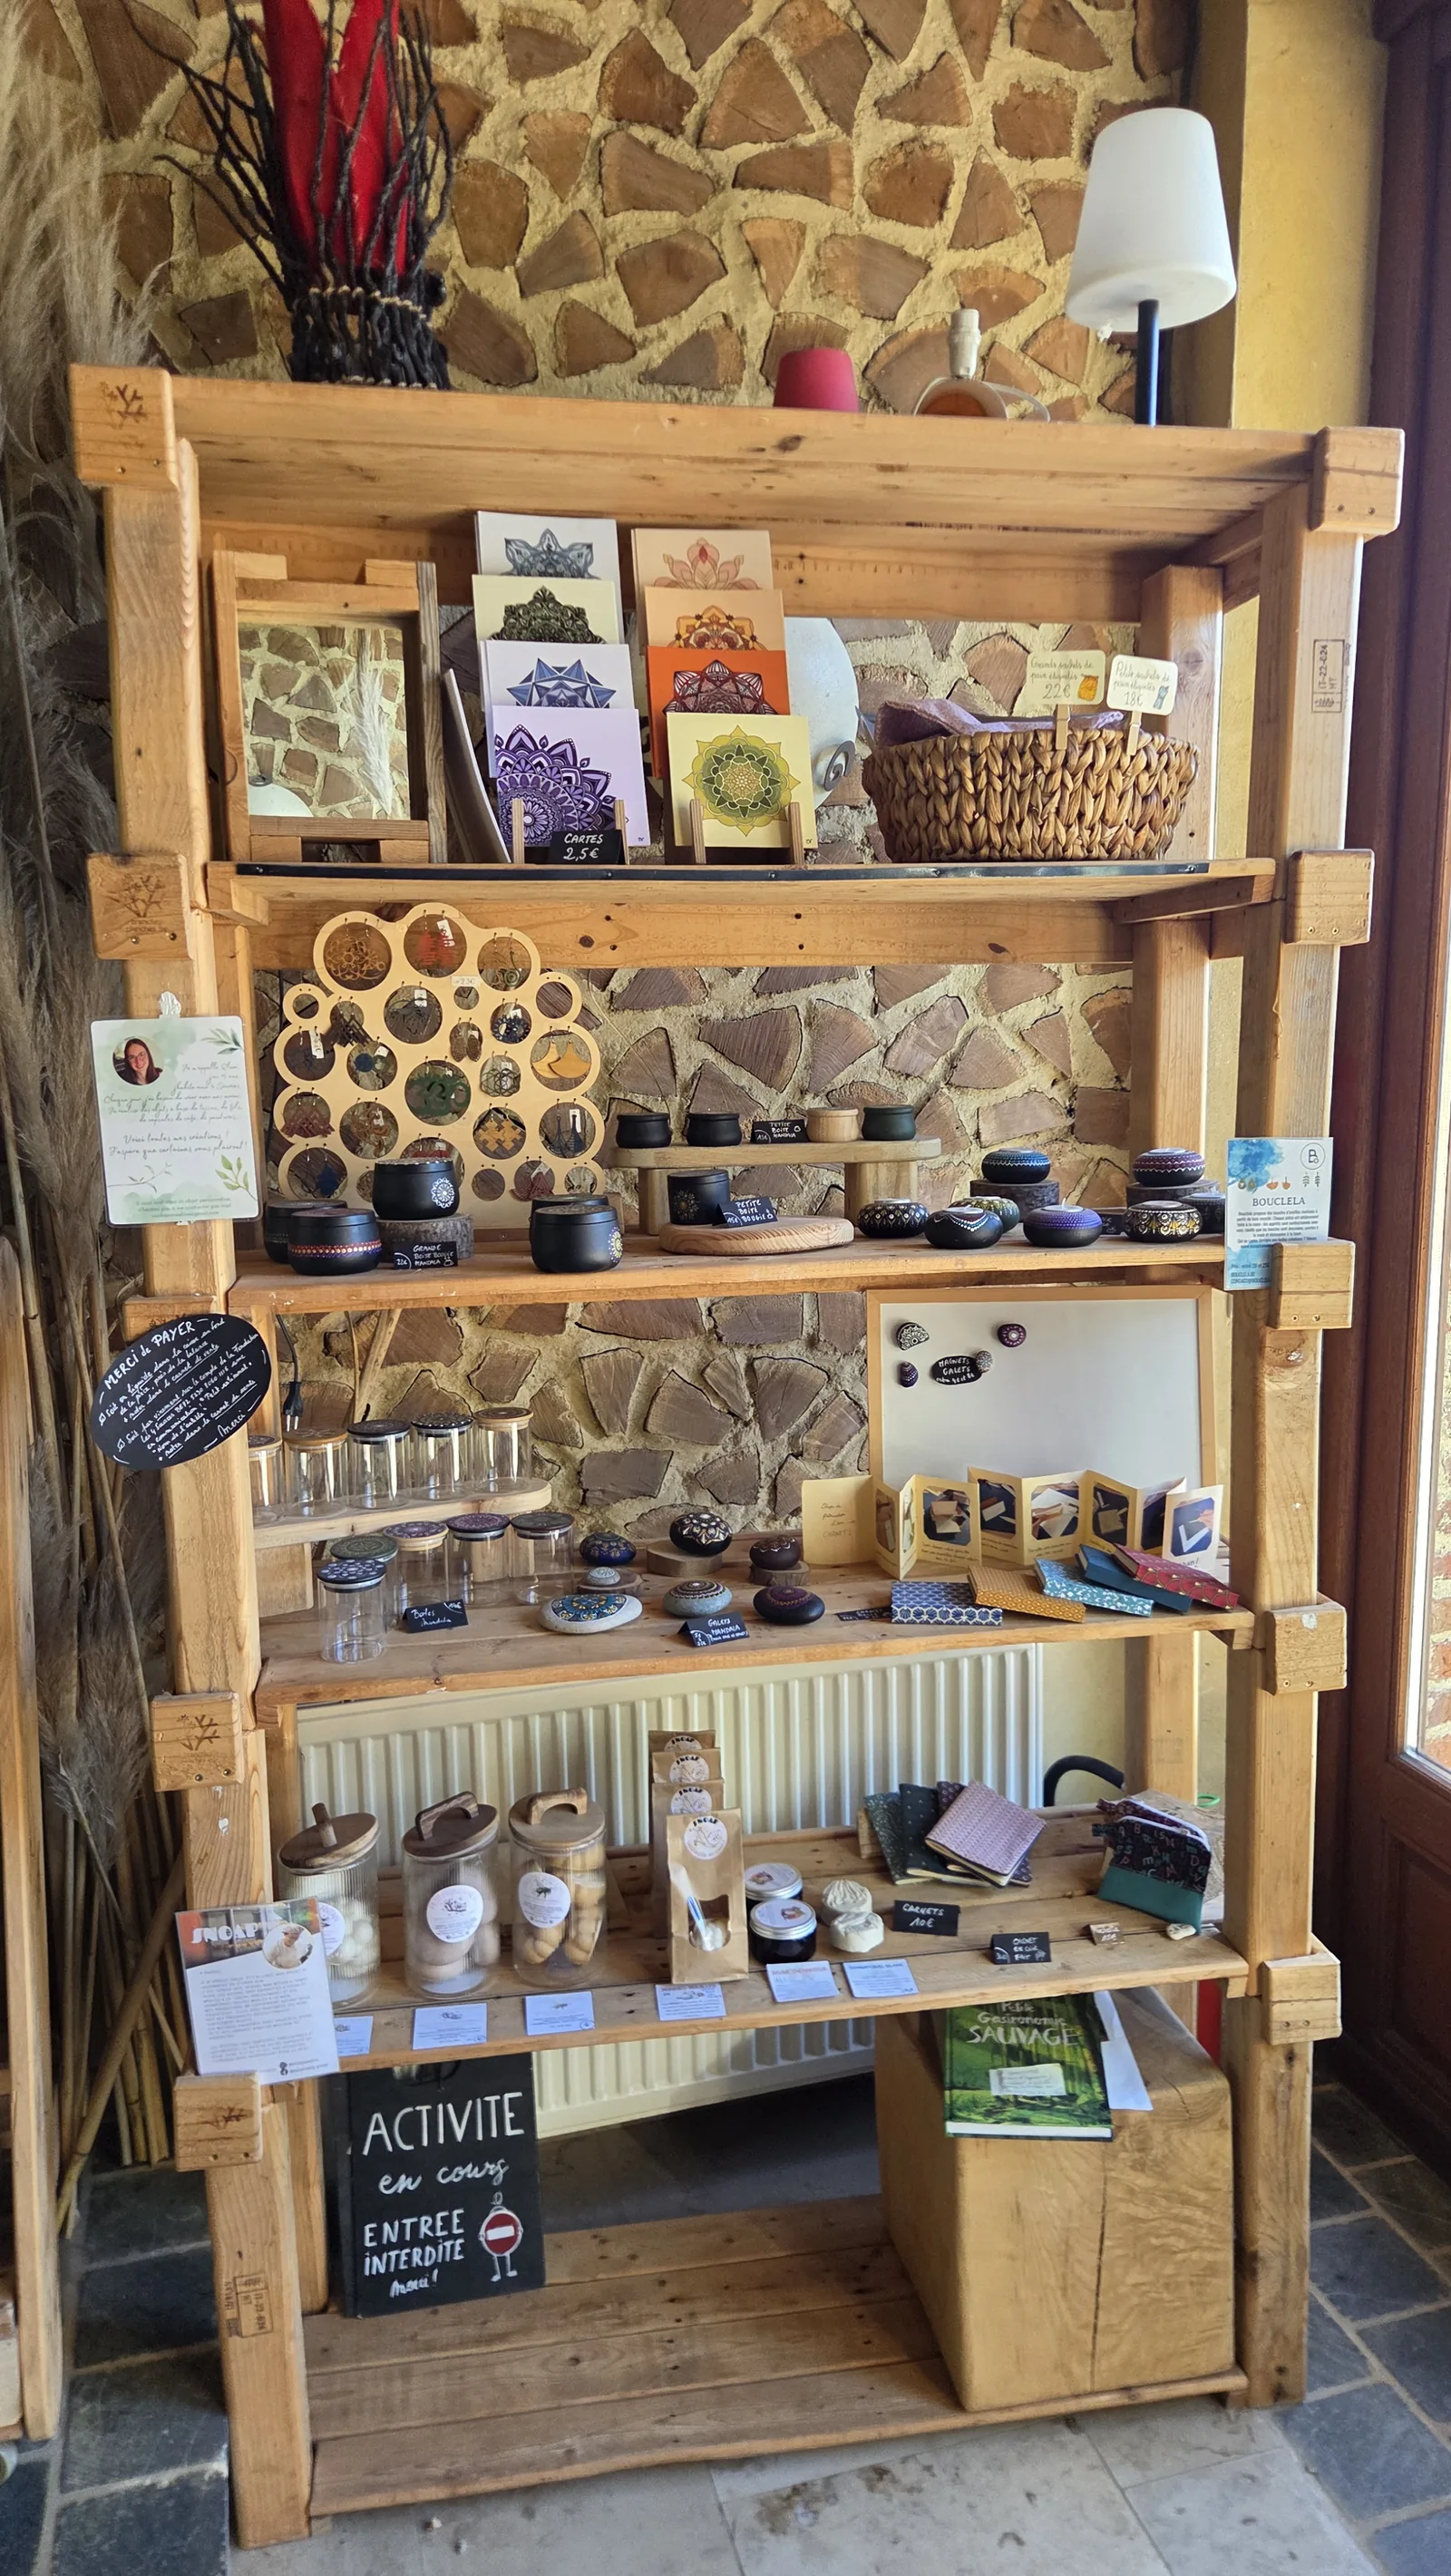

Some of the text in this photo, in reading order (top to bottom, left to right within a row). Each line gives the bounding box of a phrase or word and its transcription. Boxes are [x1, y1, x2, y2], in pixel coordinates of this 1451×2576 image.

[1043, 683, 1071, 699] 22€
[1124, 691, 1144, 707] 18€
[564, 832, 604, 844] CARTES
[563, 847, 599, 861] 2,5€
[1252, 1197, 1305, 1206] BOUCLELA
[140, 1344, 151, 1357] de
[151, 1321, 196, 1347] PAYER
[939, 1357, 969, 1367] MAGNETS
[943, 1366, 970, 1375] GALETS
[217, 1409, 246, 1437] Merci
[708, 1618, 731, 1627] GALETS
[711, 1624, 741, 1635] MANDALA
[902, 1902, 945, 1916] CARNETS
[909, 1917, 935, 1928] 10€
[190, 1922, 258, 1944] SNOAP
[1001, 2001, 1036, 2012] Petite
[978, 2012, 1067, 2026] Gastronomie
[966, 2025, 1081, 2046] SAUVAGE
[362, 2091, 525, 2156] ACTIVITE
[378, 2157, 510, 2195] en cours
[364, 2208, 465, 2248] ENTREE
